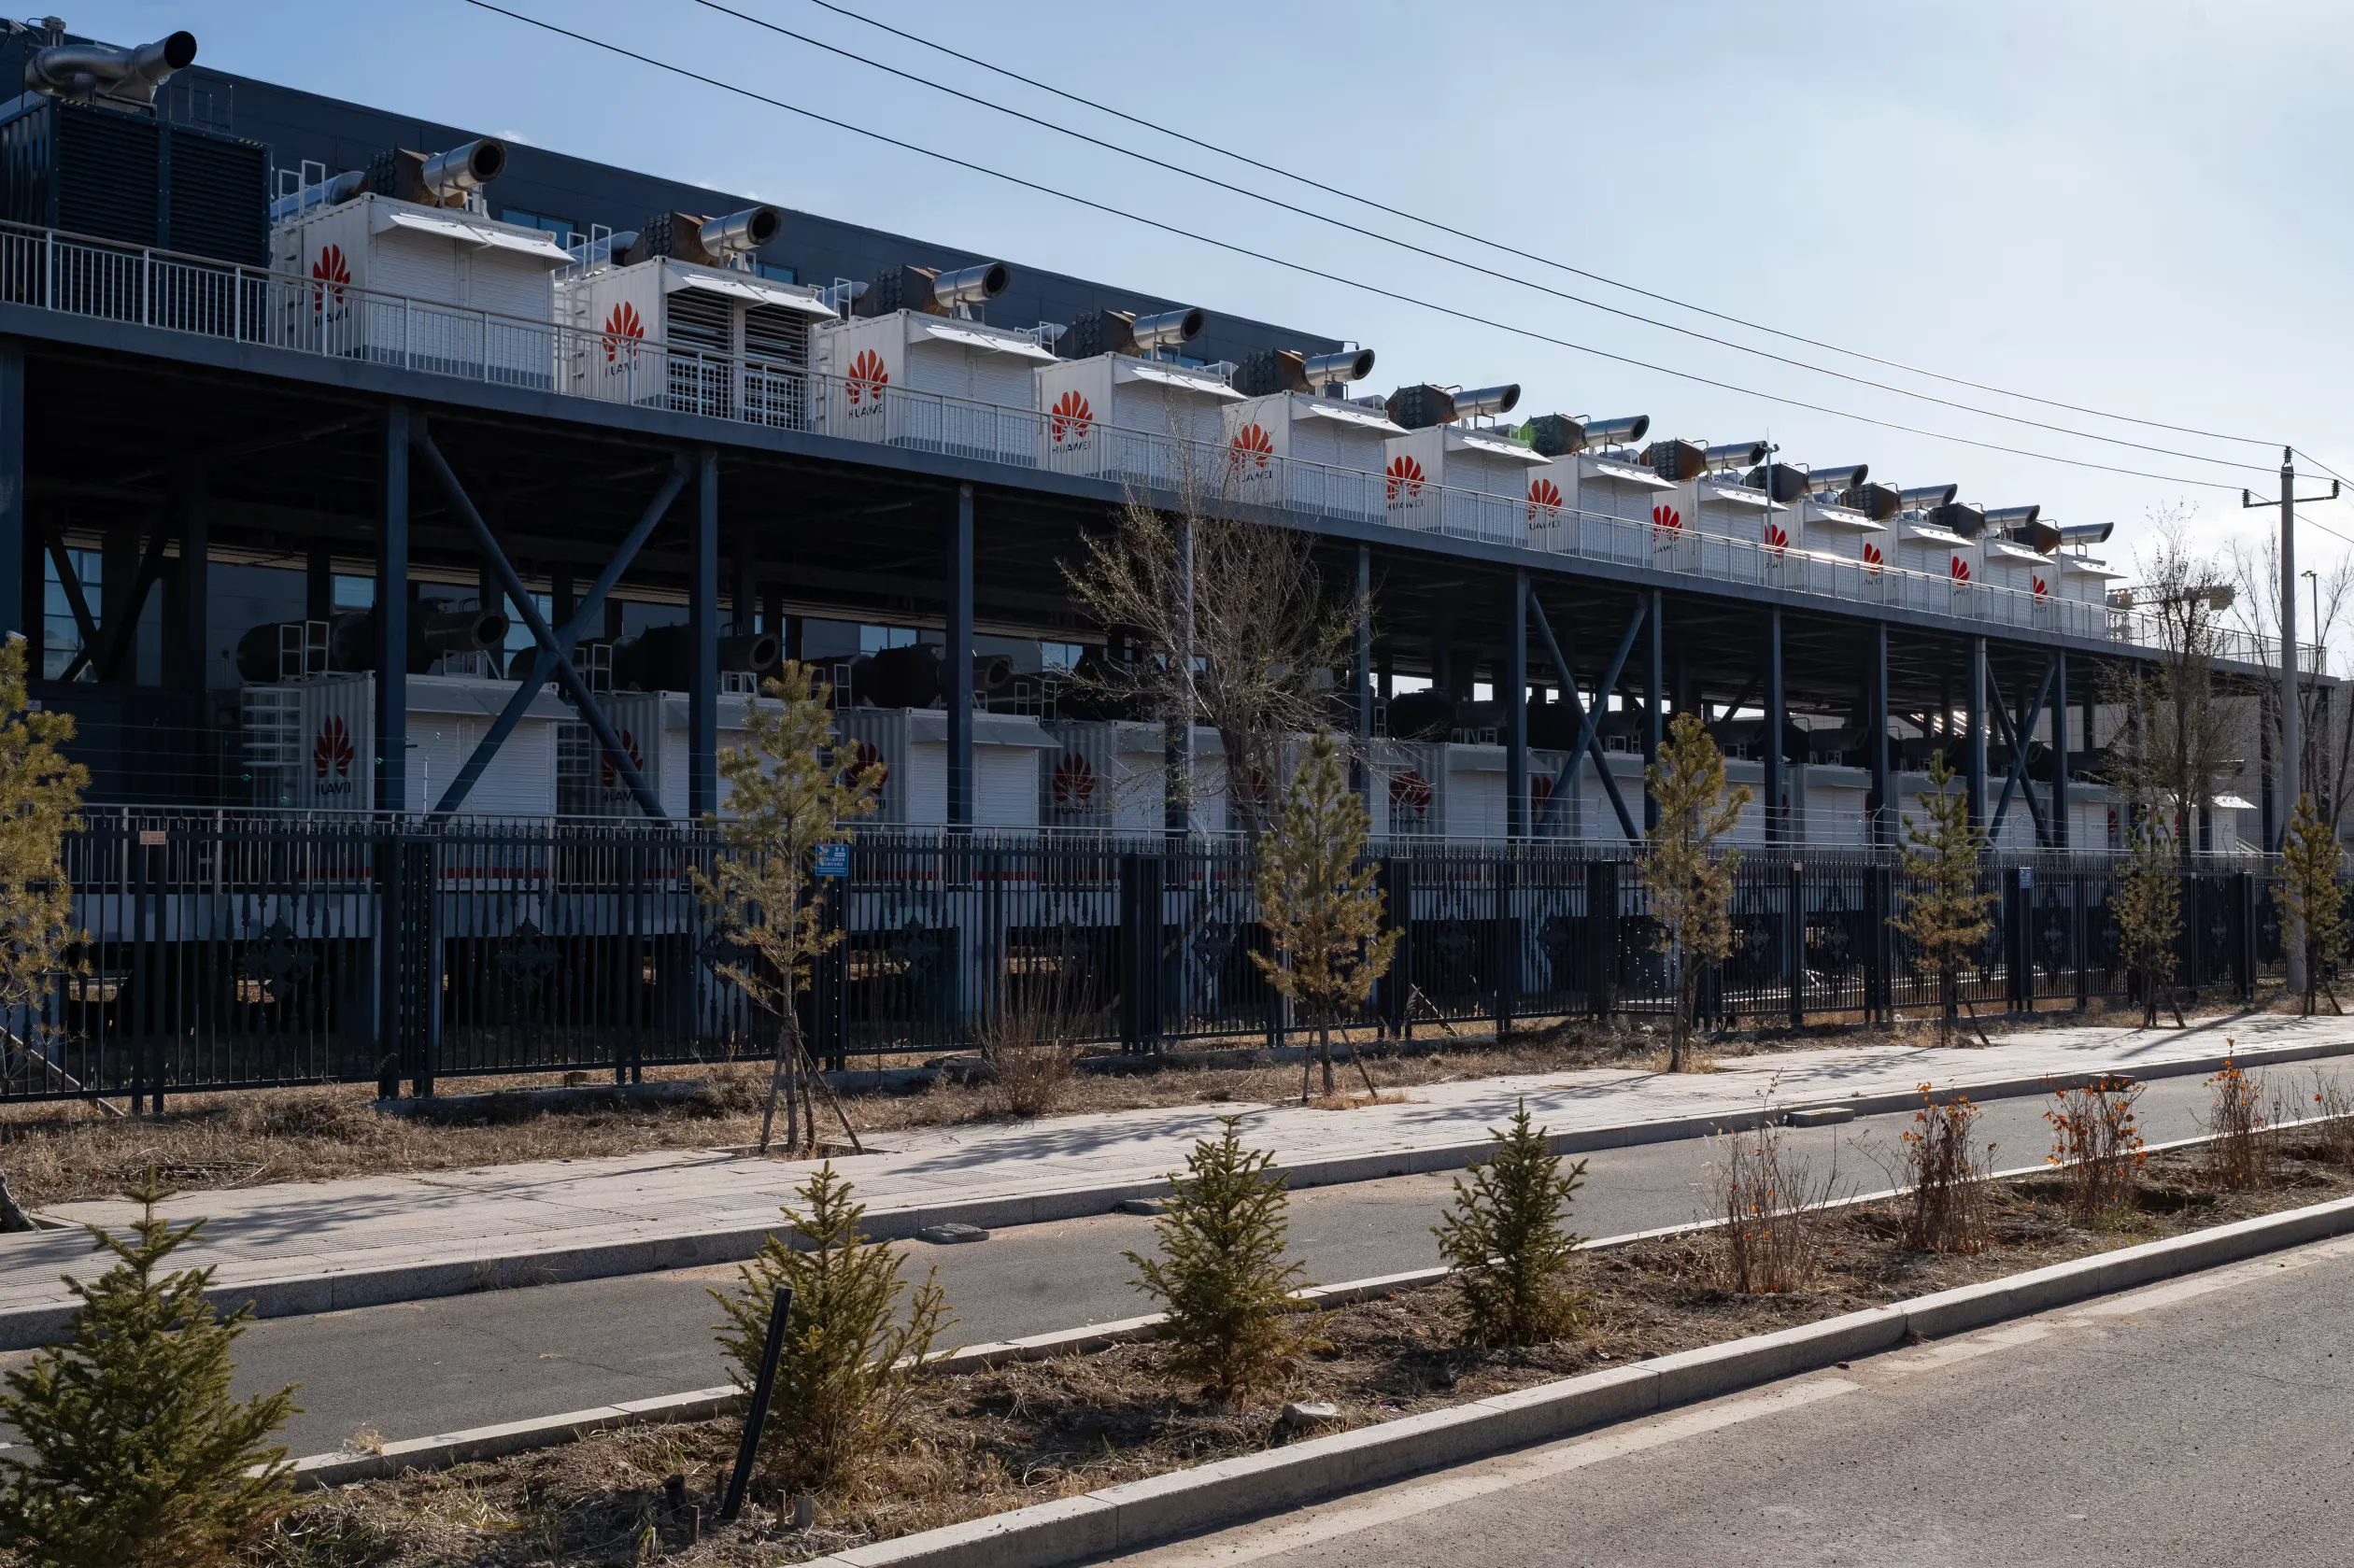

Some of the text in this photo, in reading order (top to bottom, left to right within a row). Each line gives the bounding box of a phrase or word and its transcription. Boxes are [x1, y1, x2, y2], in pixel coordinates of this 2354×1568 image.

[315, 306, 348, 327] HAWI
[848, 403, 883, 419] HUAWE
[1052, 441, 1091, 455] HUAWEI
[1528, 520, 1561, 530] UAWEI
